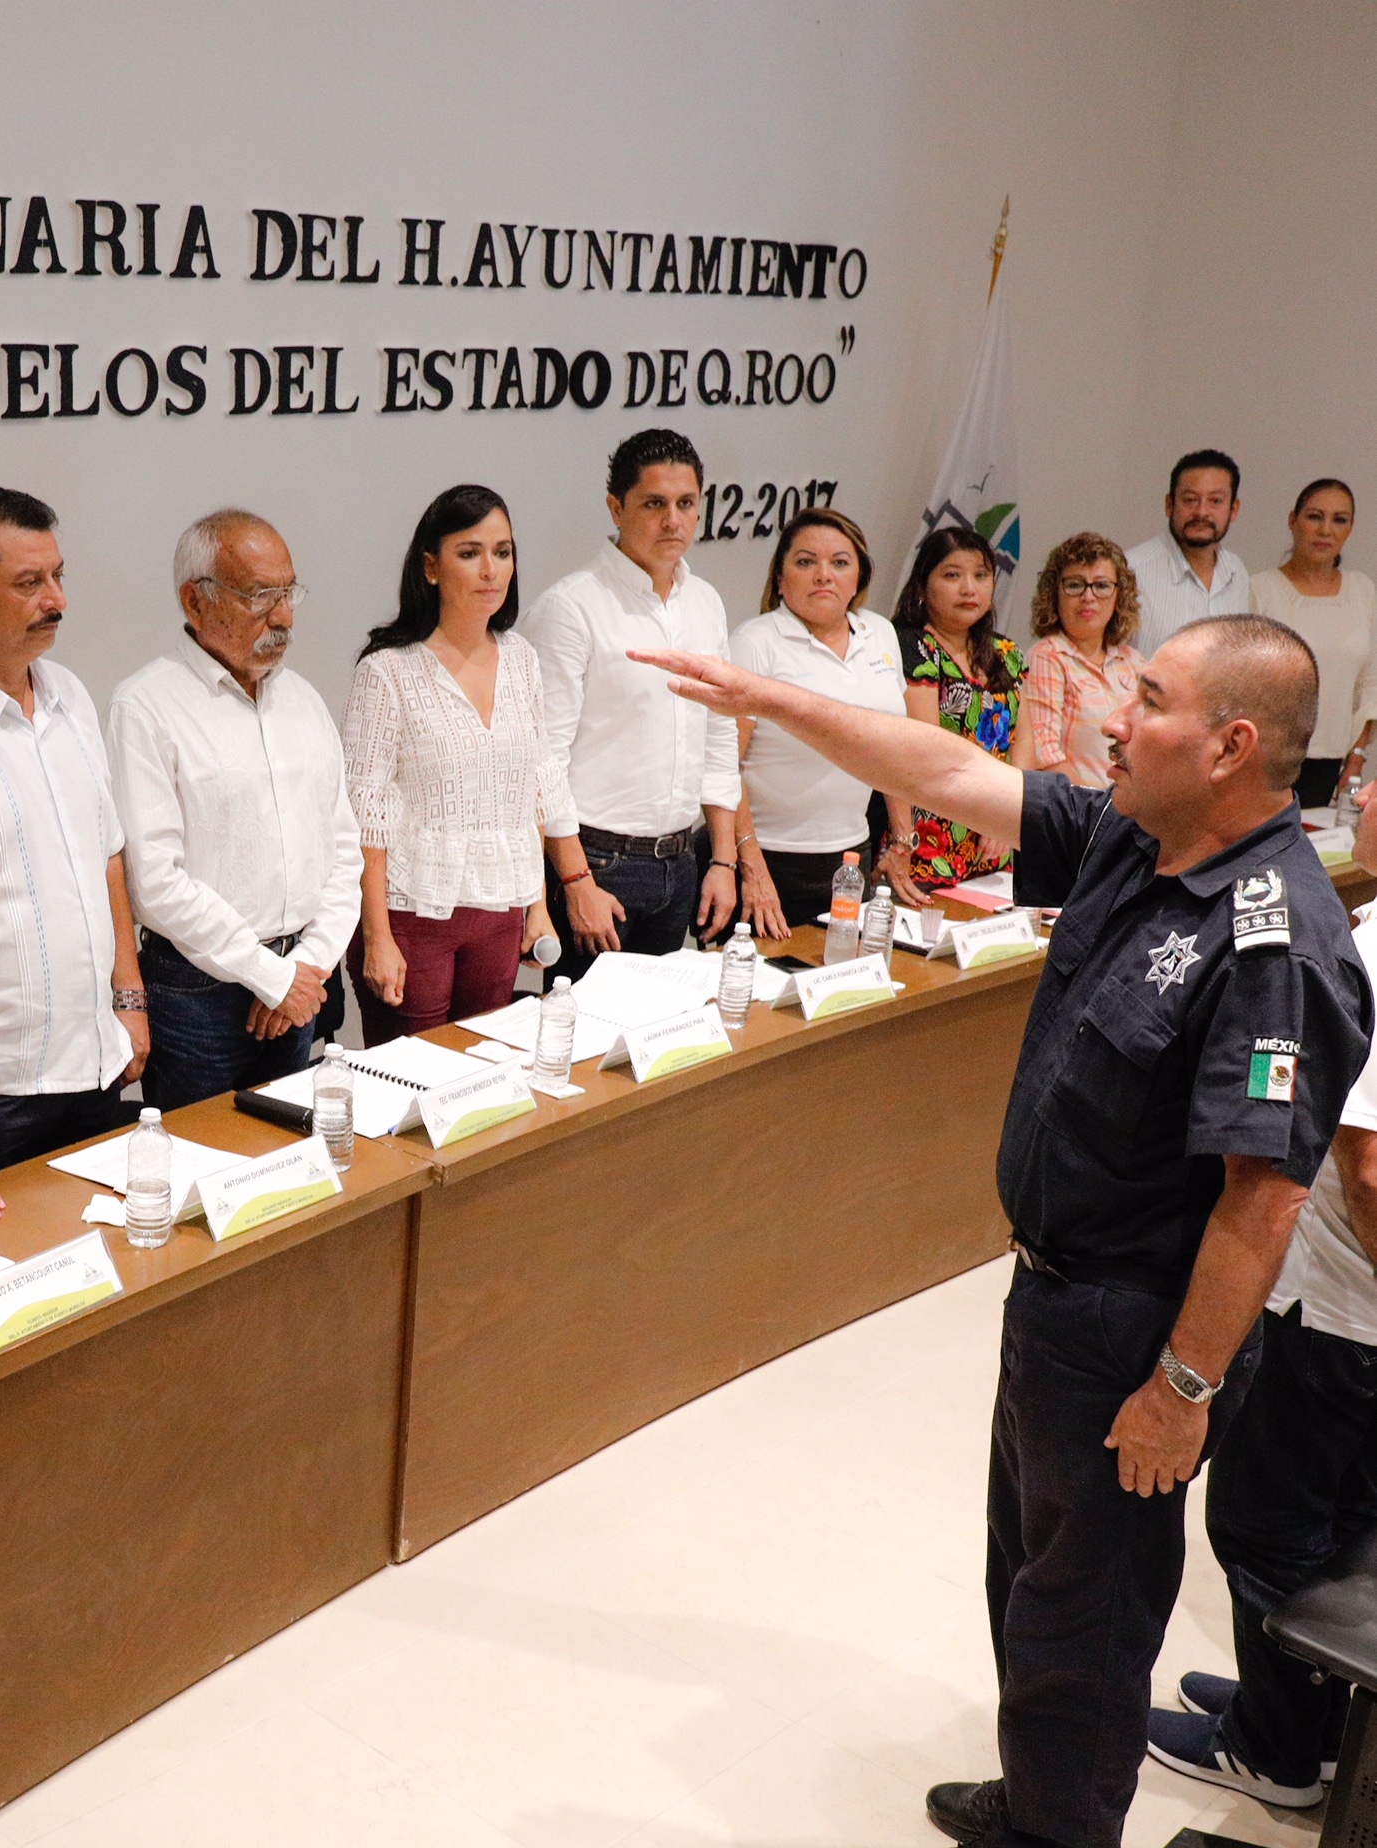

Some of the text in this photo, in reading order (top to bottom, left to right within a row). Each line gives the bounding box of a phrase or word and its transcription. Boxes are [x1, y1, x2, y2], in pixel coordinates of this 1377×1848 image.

[249, 209, 380, 285] DEL
[228, 346, 360, 416] DEL
[381, 347, 612, 414] ESTADO
[623, 349, 689, 410] DE
[644, 1031, 662, 1042] LAURA
[448, 1085, 473, 1102] FRANCISCO
[223, 1173, 251, 1190] ANTONIO
[285, 1154, 303, 1167] OLÁN
[14, 1264, 54, 1290] BETANCOURT
[54, 1256, 76, 1272] CANUL
